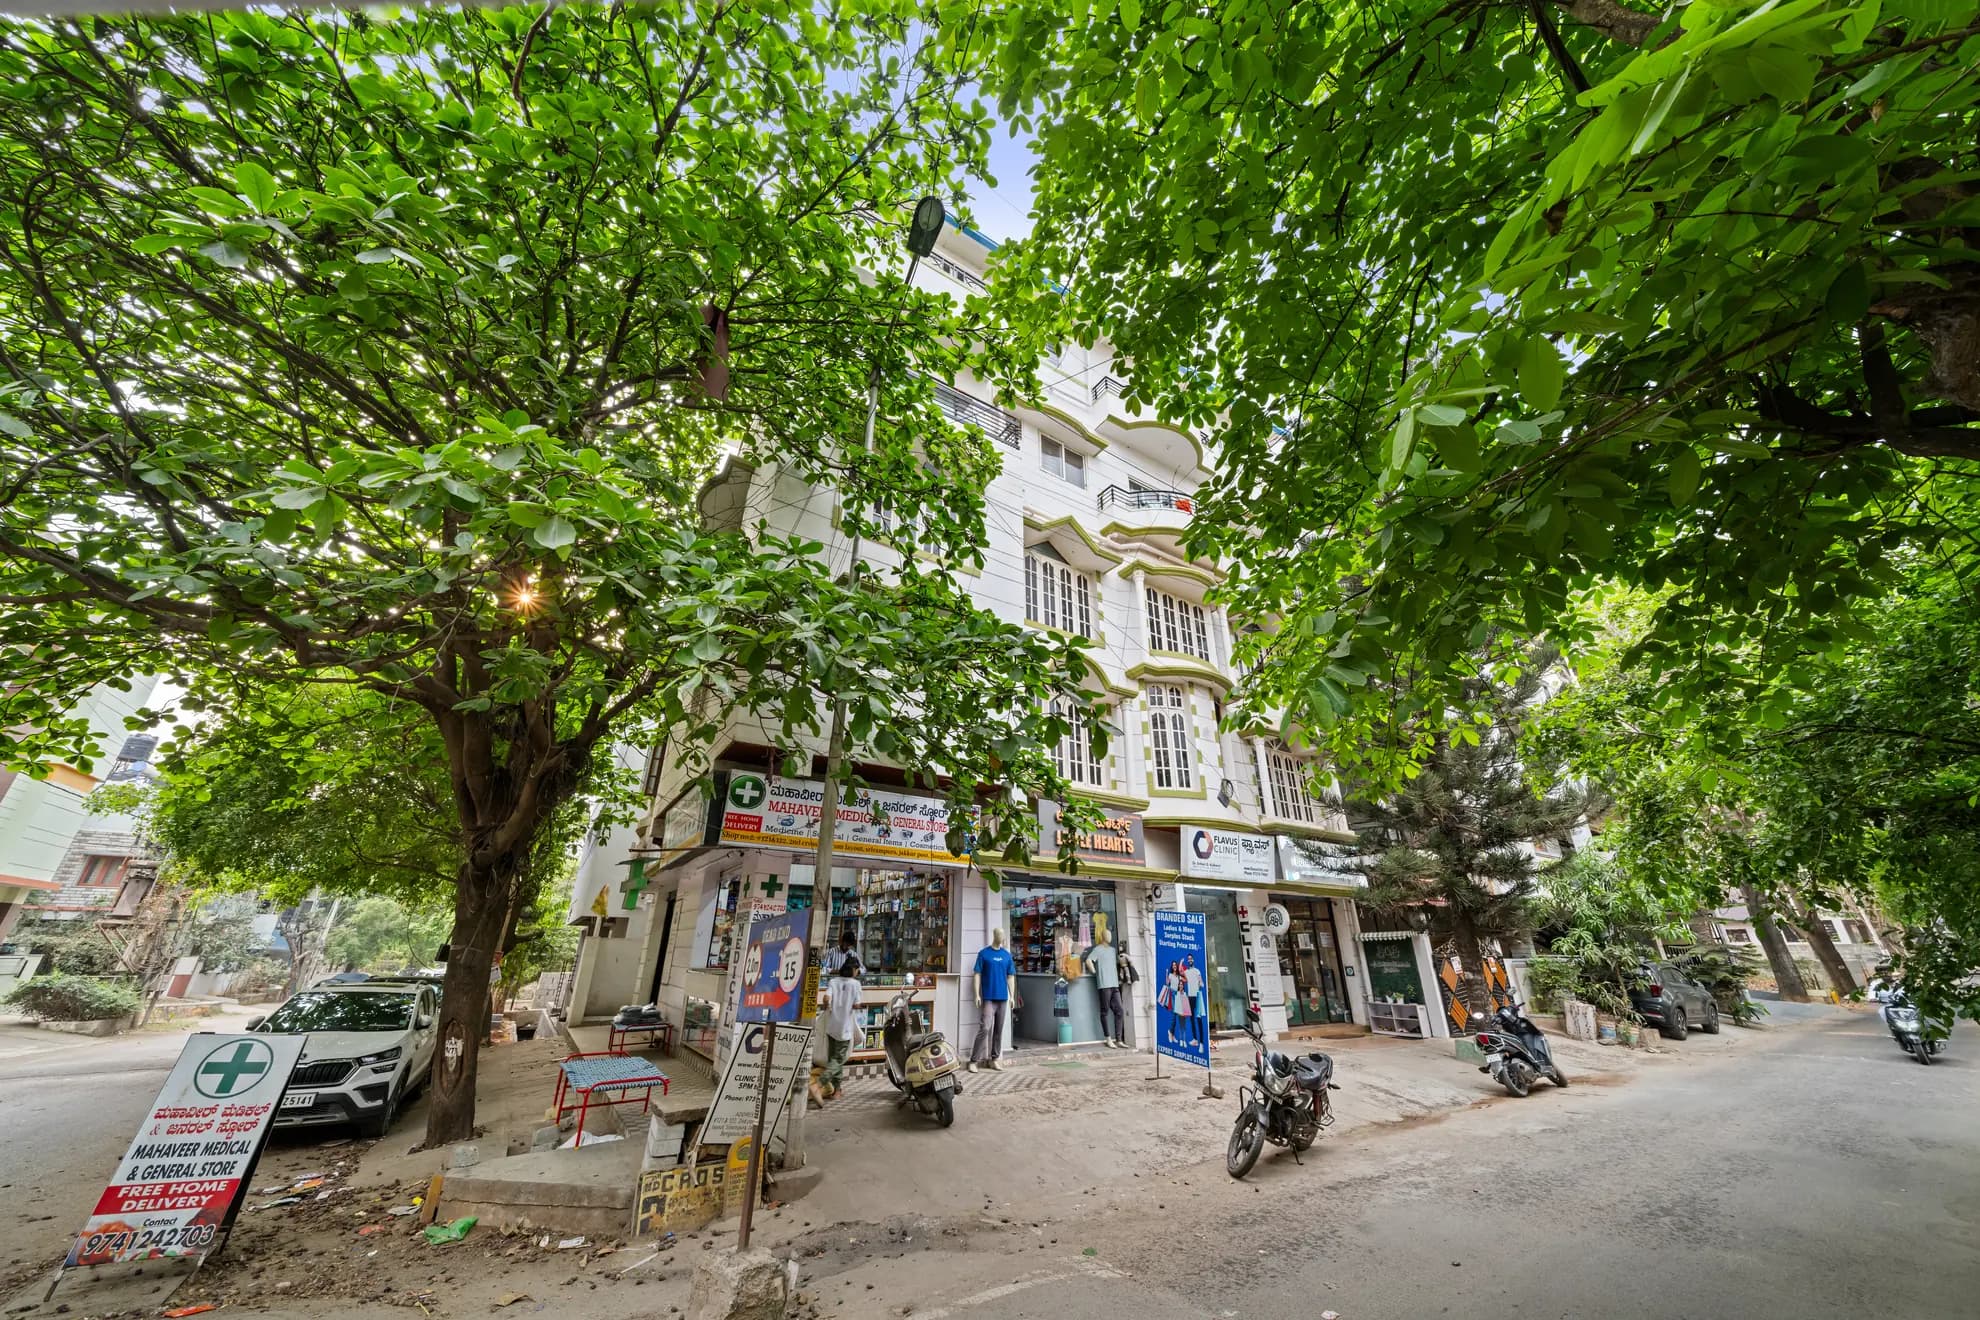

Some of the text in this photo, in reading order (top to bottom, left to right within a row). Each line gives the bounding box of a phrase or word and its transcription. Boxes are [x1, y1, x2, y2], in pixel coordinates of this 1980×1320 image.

[768, 800, 824, 818] MAHAVE
[836, 809, 884, 825] MEDIC
[893, 816, 925, 830] GENERAL
[926, 820, 948, 833] STORE
[765, 825, 804, 837] Medicine
[852, 835, 881, 844] General
[909, 841, 945, 851] Cosmetics
[1094, 834, 1134, 854] HEARTS
[1214, 835, 1238, 846] FLAVUS
[1213, 845, 1238, 855] CLINIC
[1156, 912, 1204, 925] BRANDED SALE
[784, 960, 797, 981] 15
[734, 1074, 757, 1083] CLINIC
[724, 1094, 744, 1103] Phone:
[153, 1102, 272, 1119] ಮಹಾವೀರ್ ಮೆಡಿಕಲ್
[166, 1119, 215, 1135] ಜನರಲ್
[215, 1117, 260, 1140] ಸ್ಟೋರ್
[130, 1140, 252, 1160] MAHAVEER MEDICAL
[126, 1160, 238, 1181] & GENERAL STORE
[117, 1180, 230, 1198] FREE HOME
[120, 1194, 215, 1212] DELIVERY
[142, 1216, 178, 1227] Contact
[83, 1224, 217, 1256] 9741242703
